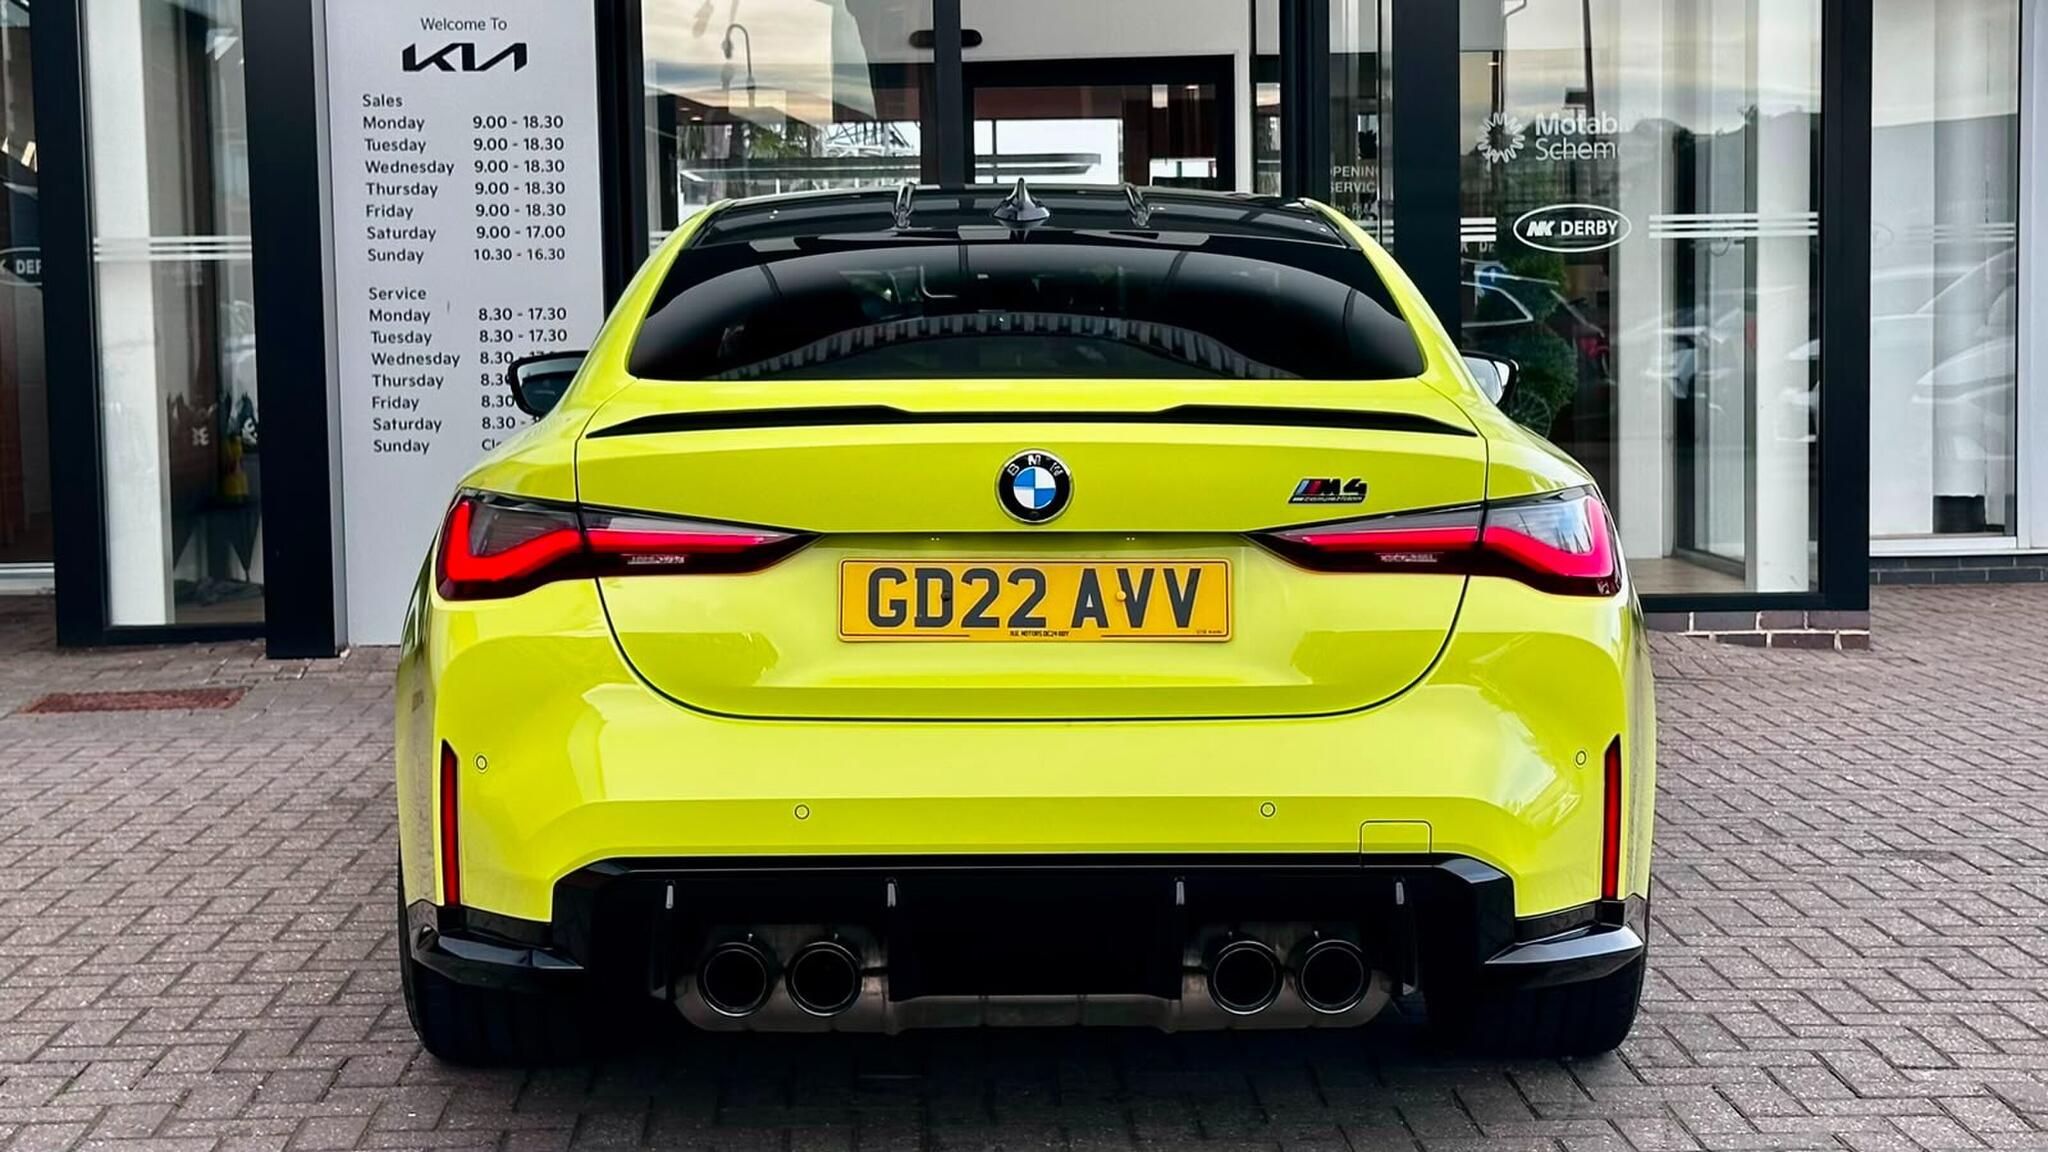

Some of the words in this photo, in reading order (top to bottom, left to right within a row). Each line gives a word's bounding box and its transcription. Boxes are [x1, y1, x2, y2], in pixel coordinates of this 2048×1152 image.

[419, 17, 486, 31] Welcome
[489, 17, 507, 31] To
[402, 42, 527, 72] KIA
[362, 93, 403, 107] Sales
[362, 116, 425, 132] Monday
[472, 115, 507, 129] 9.00
[522, 115, 563, 129] 18.30
[1535, 111, 1618, 136] Motab
[363, 138, 426, 154] Tuesday
[472, 137, 508, 151] 9.00
[522, 137, 564, 151] 18.30
[1535, 137, 1621, 161] Schem
[364, 160, 454, 176] Wednesday
[473, 160, 508, 173] 9.00
[523, 159, 565, 173] 18.30
[1330, 165, 1377, 177] PENIN
[364, 182, 438, 198] Thursday
[474, 181, 509, 195] 9.00
[524, 181, 565, 195] 18.30
[365, 204, 413, 221] Friday
[475, 203, 509, 217] 9.00
[525, 203, 566, 217] 18.30
[366, 226, 436, 242] Saturday
[475, 225, 510, 239] 9.00
[525, 225, 565, 239] 17.00
[1526, 220, 1555, 237] NK
[1560, 219, 1619, 236] DERBY
[367, 248, 424, 264] Sunday
[473, 248, 512, 261] 10.30
[526, 248, 565, 260] 16.30
[368, 287, 426, 300] Service
[368, 308, 430, 325] Monday
[478, 308, 512, 321] 8.30
[527, 307, 566, 320] 17.30
[369, 330, 432, 346] Tuesday
[478, 329, 513, 343] 8.30
[528, 329, 567, 342] 17.30
[370, 352, 460, 368] Wednesday
[479, 351, 514, 366] 8.30
[371, 374, 444, 390] Thursday
[371, 396, 419, 412] Friday
[480, 394, 515, 408] 8.30
[372, 417, 442, 433] Saturday
[481, 416, 515, 429] 8.30
[373, 439, 430, 455] Sunday
[1007, 454, 1064, 477] BMW
[867, 567, 1046, 629] GD22
[1071, 568, 1204, 629] AVV
